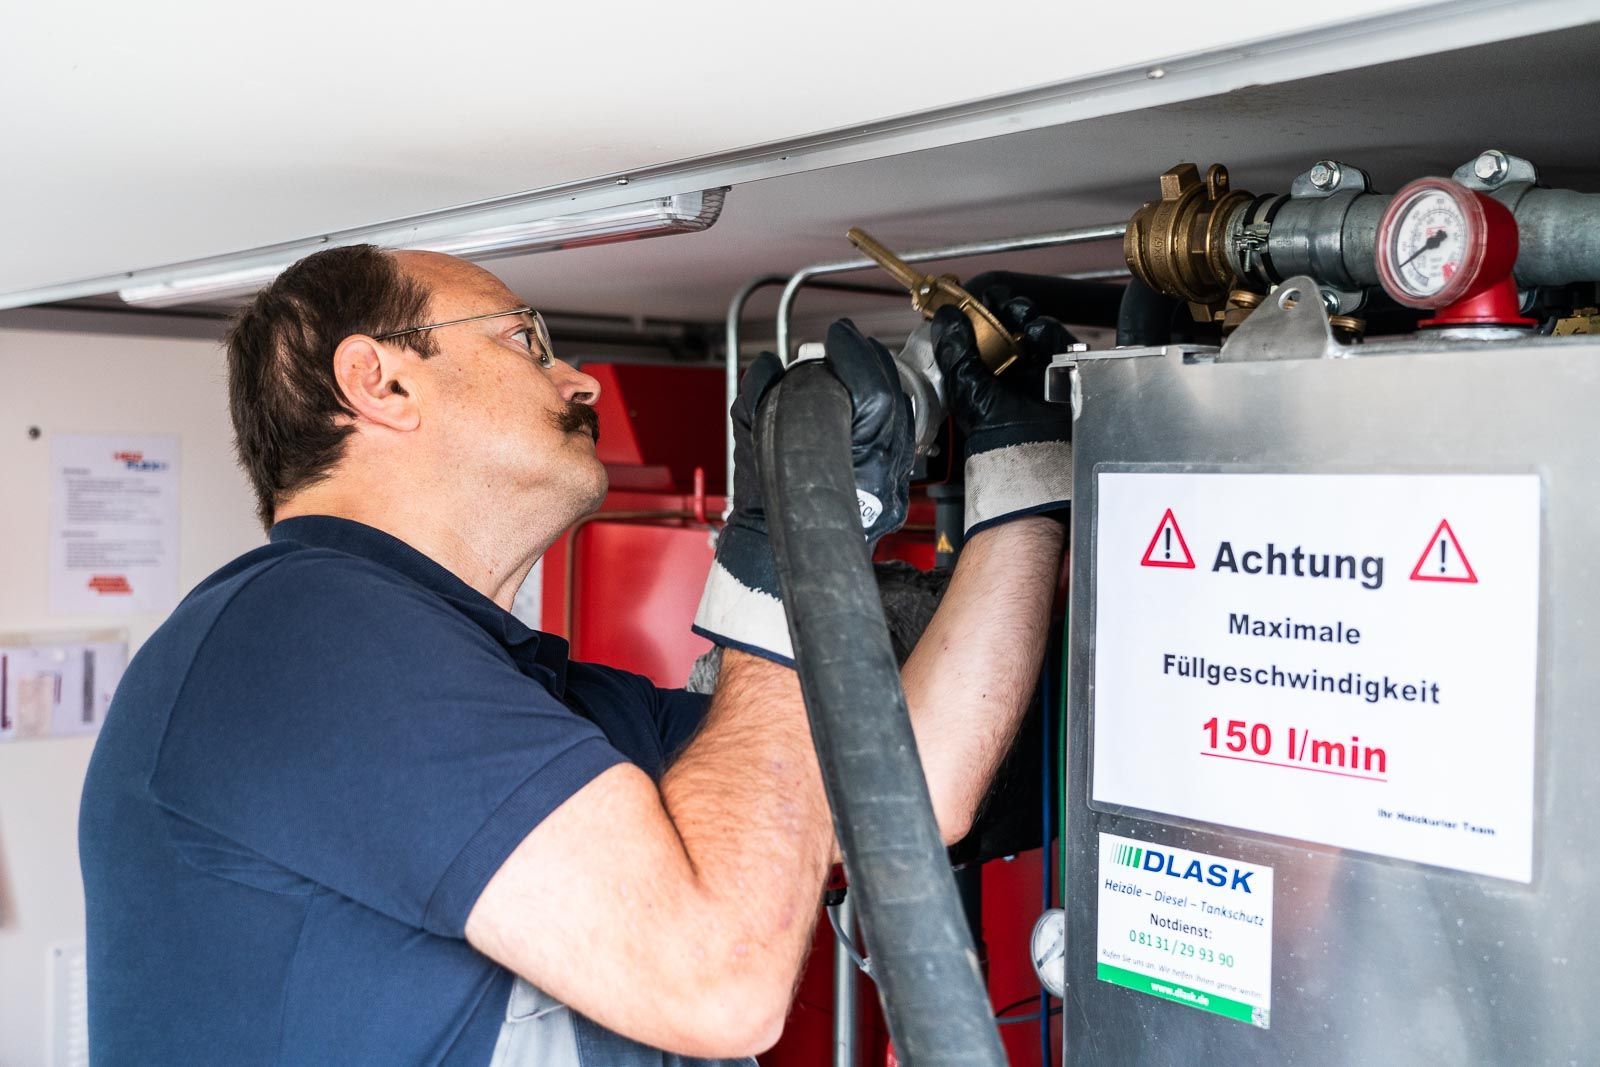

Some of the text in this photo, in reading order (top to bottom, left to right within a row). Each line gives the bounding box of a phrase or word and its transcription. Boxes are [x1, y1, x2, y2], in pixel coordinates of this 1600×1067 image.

[1211, 541, 1384, 590] Achtung
[1229, 612, 1361, 645] Maximale
[1163, 653, 1440, 704] Füllgeschwindigkeit
[1202, 717, 1387, 773] 150 l/min
[1462, 821, 1496, 836] Team
[1143, 850, 1254, 893] DLASK
[1104, 878, 1142, 897] Heizöle
[1154, 890, 1188, 907] Diesel
[1201, 901, 1265, 926] Tankschutz
[1150, 913, 1213, 939] Notdienst:
[1102, 949, 1121, 961] Rufen
[1158, 964, 1171, 975] Wir
[1199, 947, 1214, 963] 93
[1218, 952, 1234, 968] 90
[1150, 981, 1210, 1006] www.dlask.de
